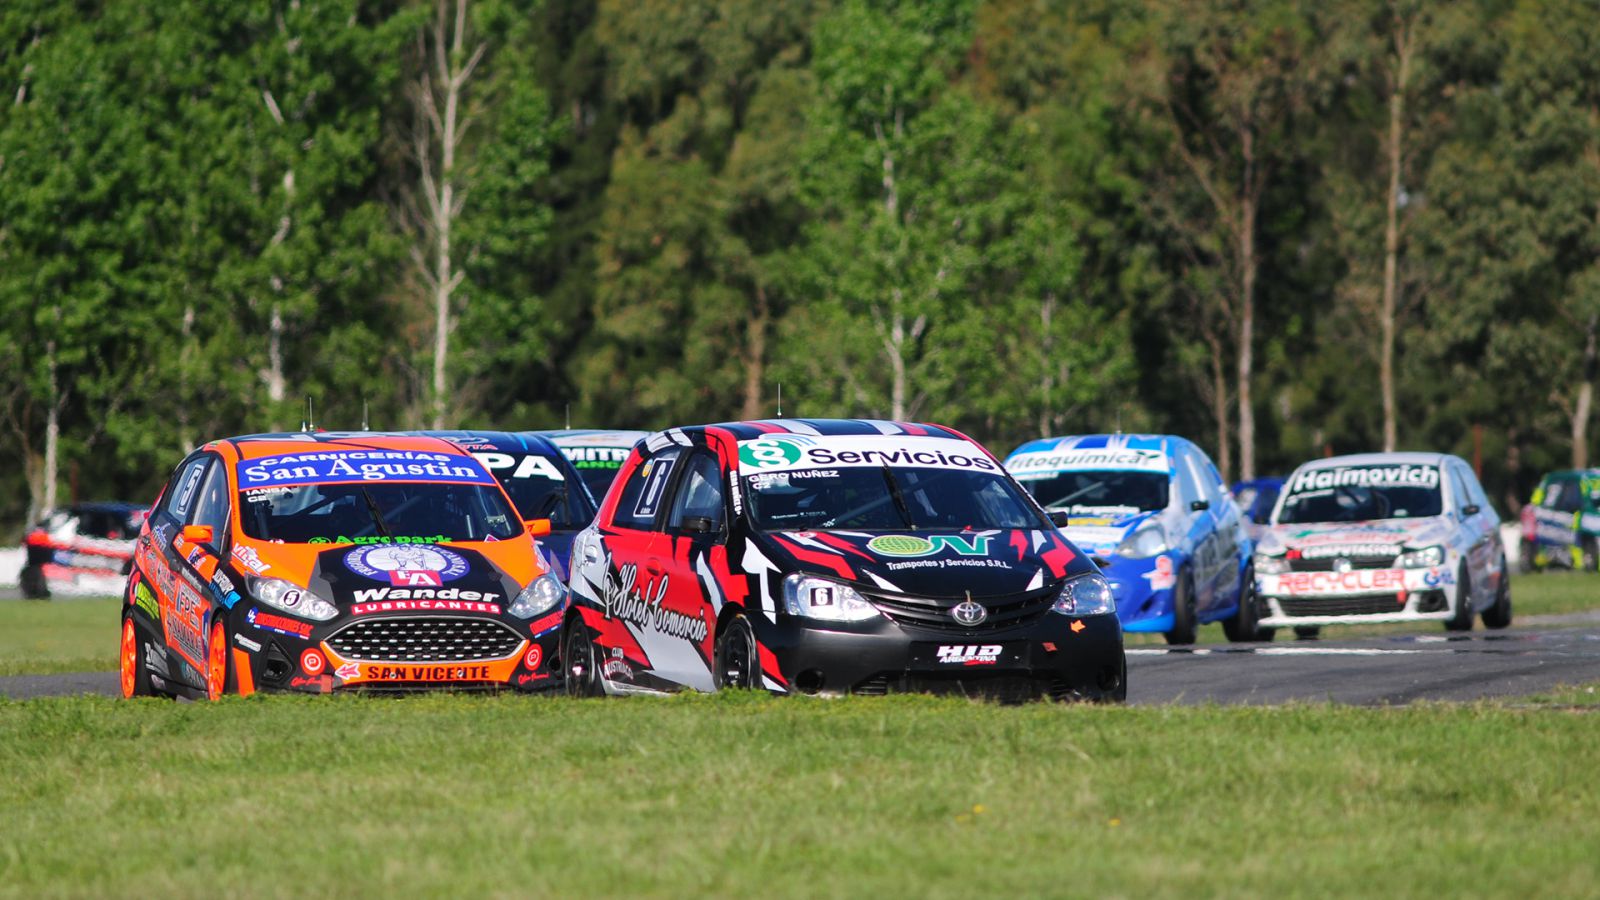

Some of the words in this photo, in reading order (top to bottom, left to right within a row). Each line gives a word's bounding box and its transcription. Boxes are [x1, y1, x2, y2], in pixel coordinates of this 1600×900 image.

[260, 451, 451, 466] CARNICERÍAS
[807, 448, 996, 471] Servicios
[245, 465, 319, 482] San
[791, 469, 840, 479] NUÑEZ
[645, 462, 667, 506] 6
[886, 560, 938, 571] Transportes
[940, 559, 946, 569] y
[946, 559, 985, 567] Servicios
[353, 588, 500, 603] Wander
[613, 564, 652, 625] Hotel
[652, 574, 708, 641] Comercio
[815, 587, 828, 606] 6
[354, 601, 499, 614] LUBRICANTES
[937, 645, 1003, 657] HID
[367, 666, 406, 680] SAN
[411, 665, 490, 681] VICENTE
